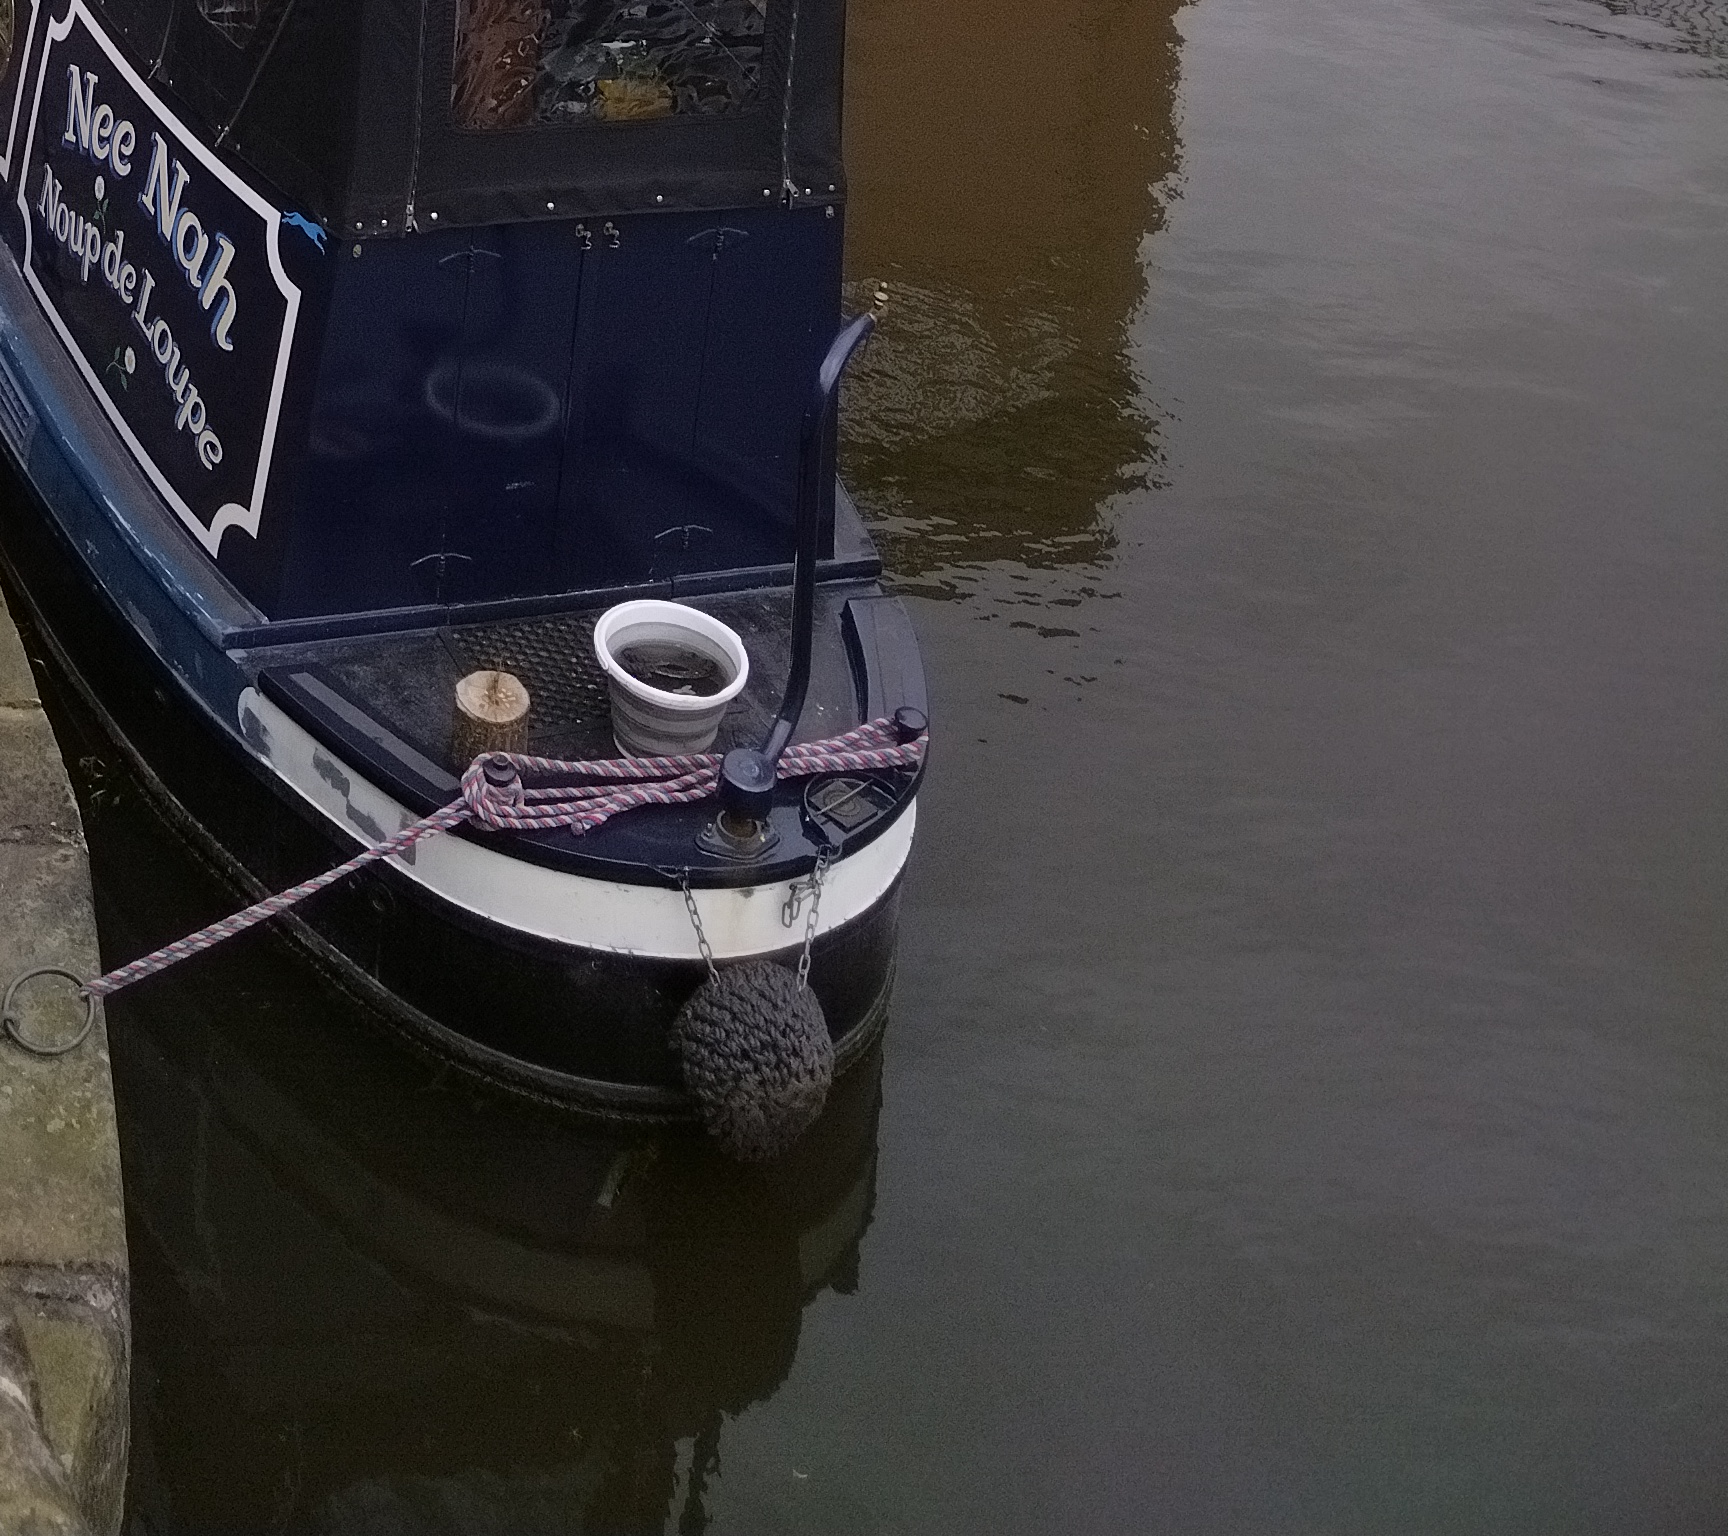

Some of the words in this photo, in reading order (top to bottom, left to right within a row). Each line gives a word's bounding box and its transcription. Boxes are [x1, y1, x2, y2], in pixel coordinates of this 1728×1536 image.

[38, 163, 101, 282] Noup
[100, 230, 137, 305] de
[131, 268, 224, 471] Loupe
[62, 64, 136, 178] Nee
[138, 131, 237, 351] Nah
